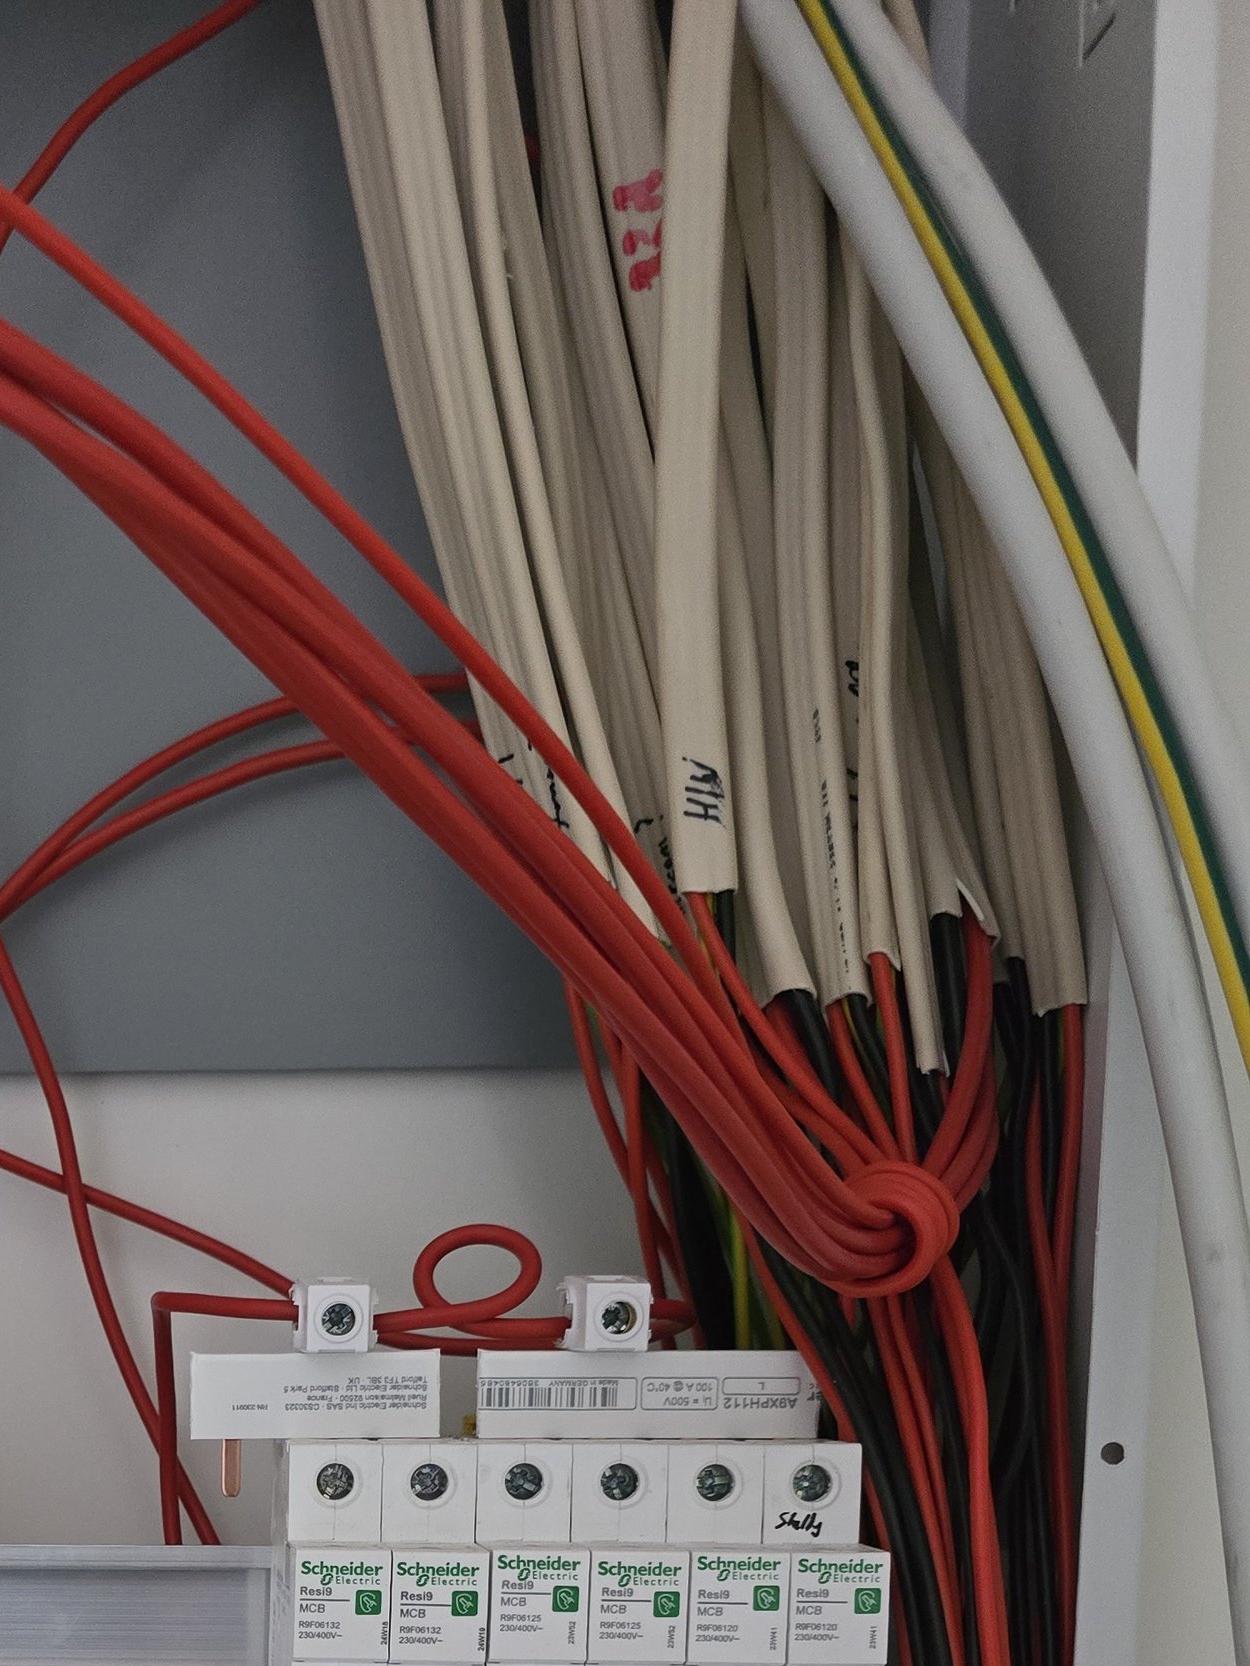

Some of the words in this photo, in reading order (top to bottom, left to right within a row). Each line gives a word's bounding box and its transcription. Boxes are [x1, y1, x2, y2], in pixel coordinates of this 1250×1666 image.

[498, 1555, 581, 1571] Schneider
[697, 1556, 781, 1572] Schneider
[798, 1558, 884, 1574] Schneider
[301, 1561, 383, 1577] Schneider
[397, 1562, 479, 1577] Schneider
[598, 1561, 682, 1577] Schneider
[532, 1571, 578, 1580] Electric
[732, 1572, 779, 1581] Electric
[833, 1574, 881, 1583] Electric
[336, 1577, 381, 1585] Electric
[431, 1578, 477, 1587] Electric
[501, 1580, 534, 1590] Resi9
[633, 1577, 679, 1586] Electric
[300, 1587, 332, 1596] Resi9
[400, 1591, 433, 1601] Resi9
[602, 1587, 634, 1597] Resi9
[698, 1589, 730, 1599] Resi9
[796, 1588, 829, 1598] Resi9
[500, 1597, 527, 1606] MCB
[300, 1604, 325, 1613] MCB
[400, 1609, 426, 1618] MCB
[600, 1604, 627, 1614] MCB
[697, 1607, 723, 1616] MCB
[796, 1605, 822, 1615] MCB
